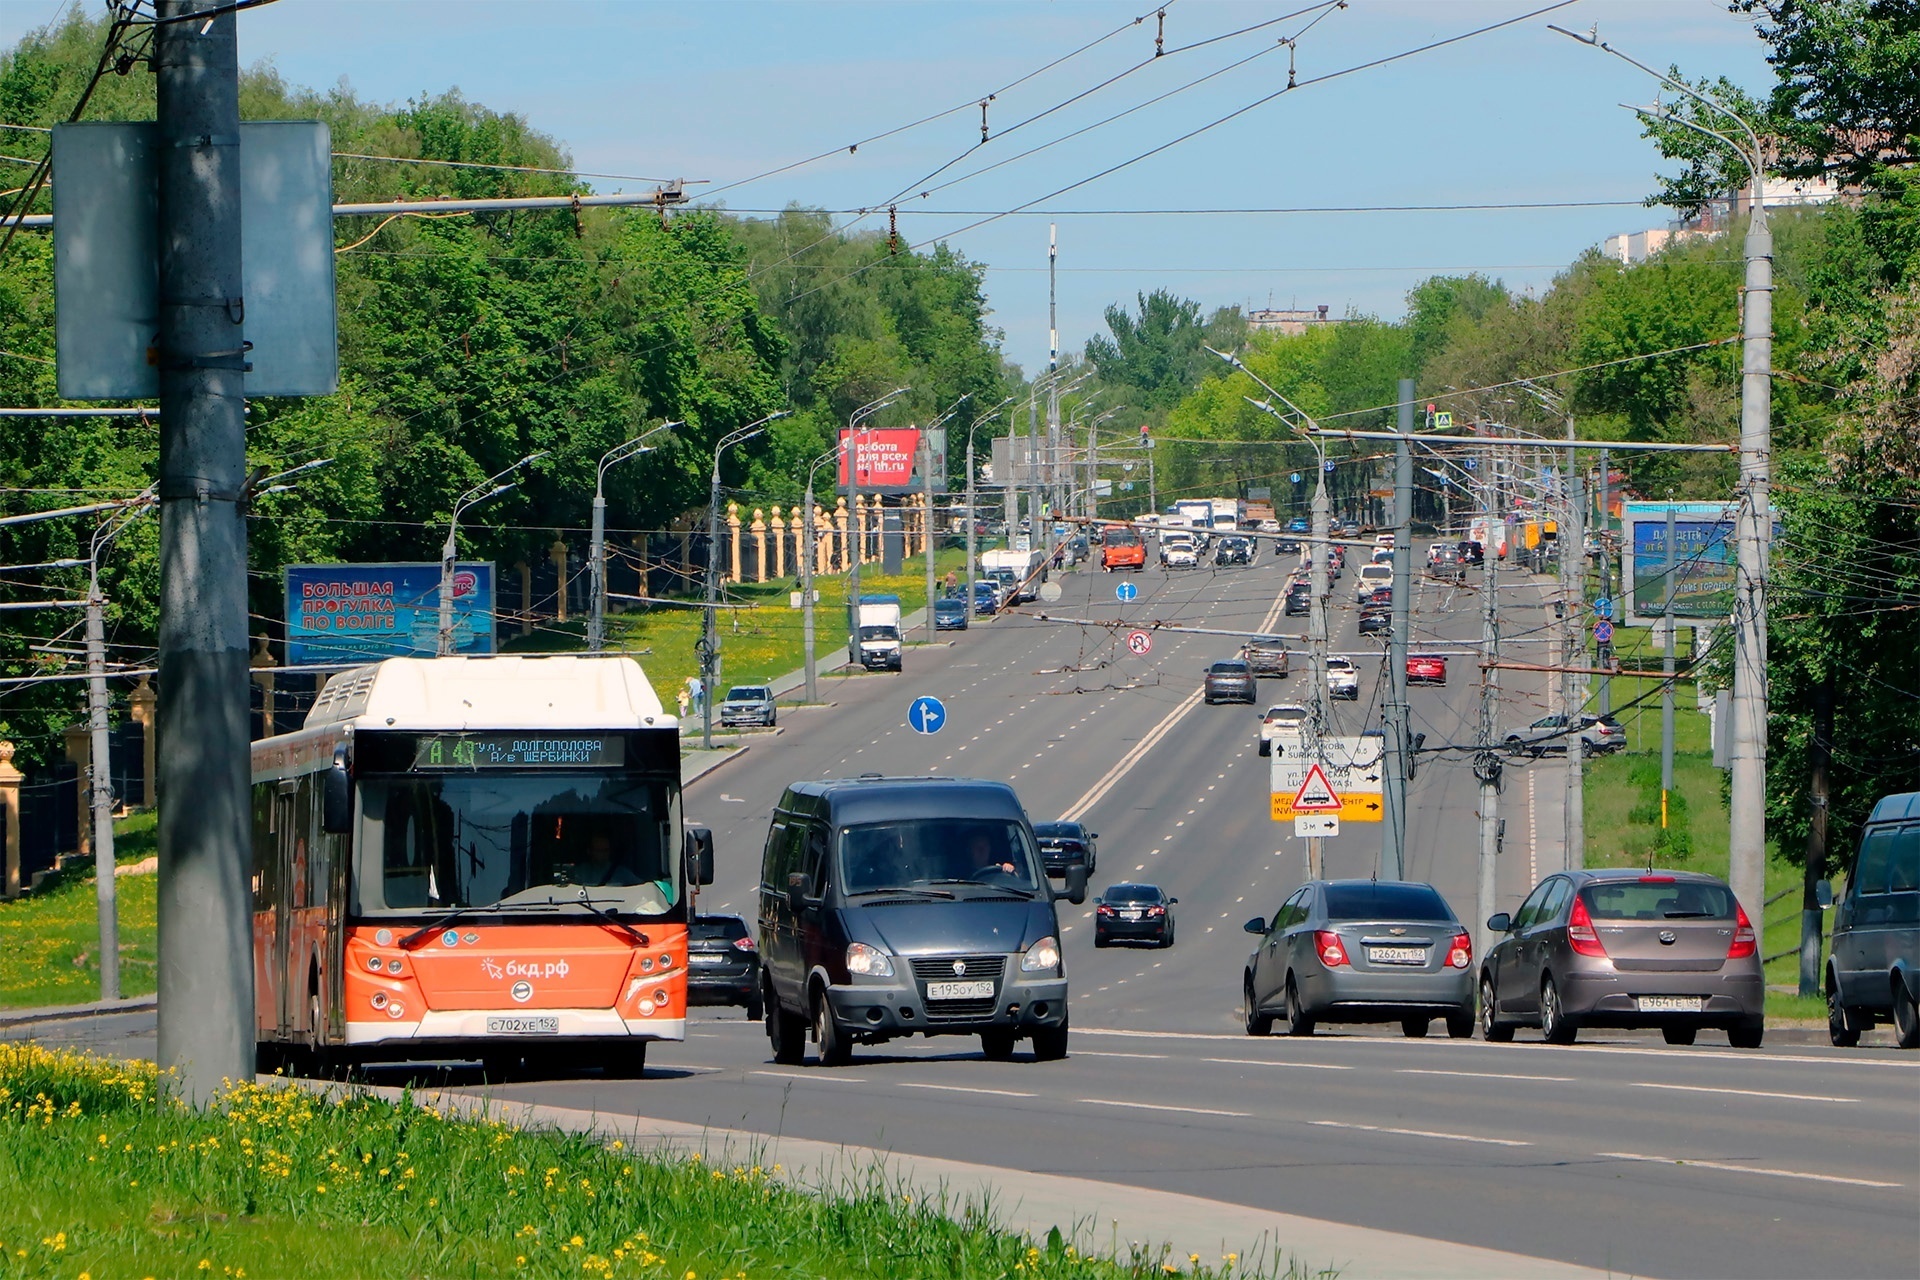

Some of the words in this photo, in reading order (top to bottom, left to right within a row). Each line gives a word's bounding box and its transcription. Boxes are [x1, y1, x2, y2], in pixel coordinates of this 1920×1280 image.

[857, 442, 898, 453] работа
[857, 452, 879, 463] для
[881, 453, 908, 461] всех
[874, 461, 904, 472] hh.ru
[303, 582, 394, 597] БОЛЬШАЯ
[302, 599, 394, 613] ПРОГУЛКА
[303, 615, 331, 630] ПО
[336, 615, 394, 629] ВОЛГЕ
[430, 741, 442, 764] А
[478, 742, 502, 753] ул.
[511, 740, 602, 752] ДОЛГОПОЛОВА
[490, 751, 516, 763] А/в
[1302, 822, 1309, 830] 3
[505, 958, 569, 979] бкд.рф
[491, 1019, 536, 1031] С702ХЕ
[538, 1018, 557, 1028] 152
